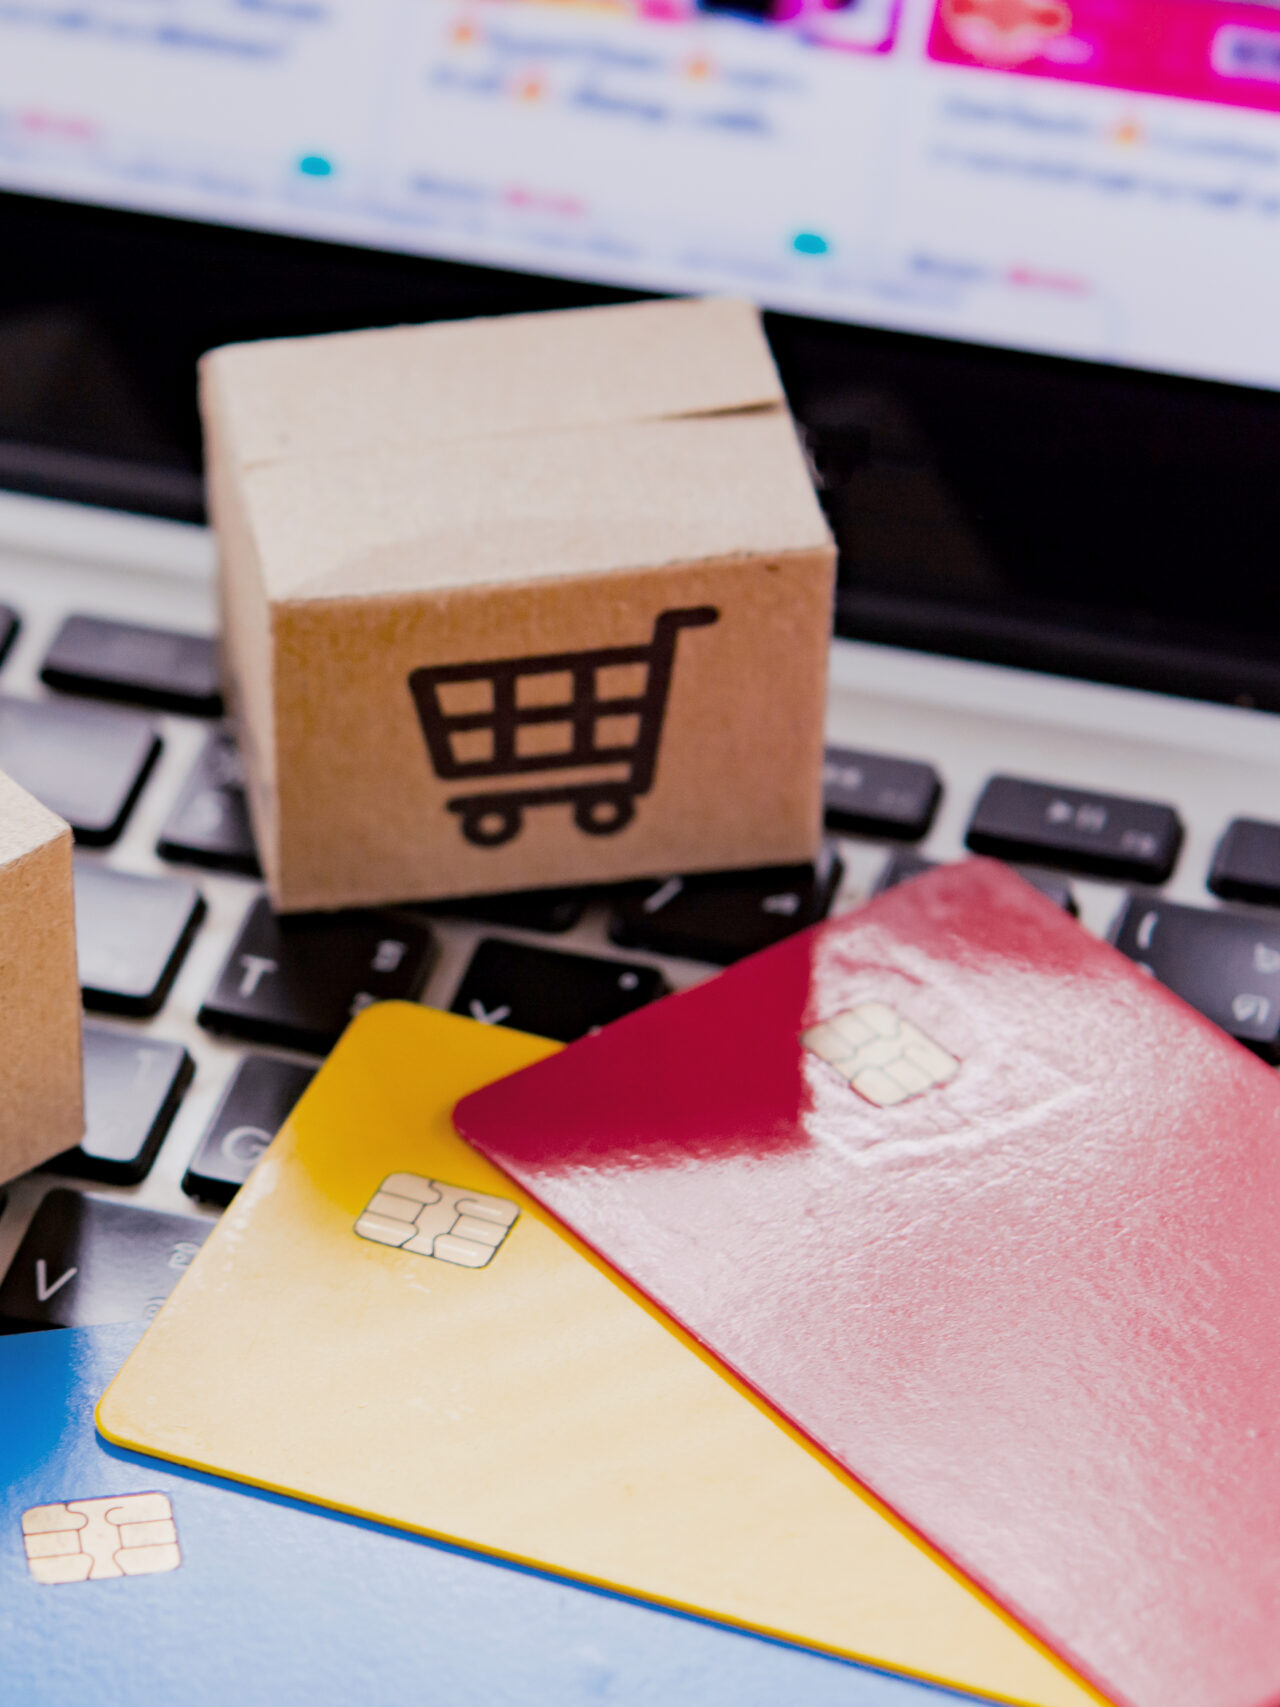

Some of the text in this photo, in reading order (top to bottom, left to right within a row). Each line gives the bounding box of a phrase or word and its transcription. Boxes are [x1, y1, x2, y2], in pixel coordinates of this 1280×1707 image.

[239, 953, 278, 999] T
[221, 1125, 274, 1166] G
[36, 1258, 79, 1302] V
